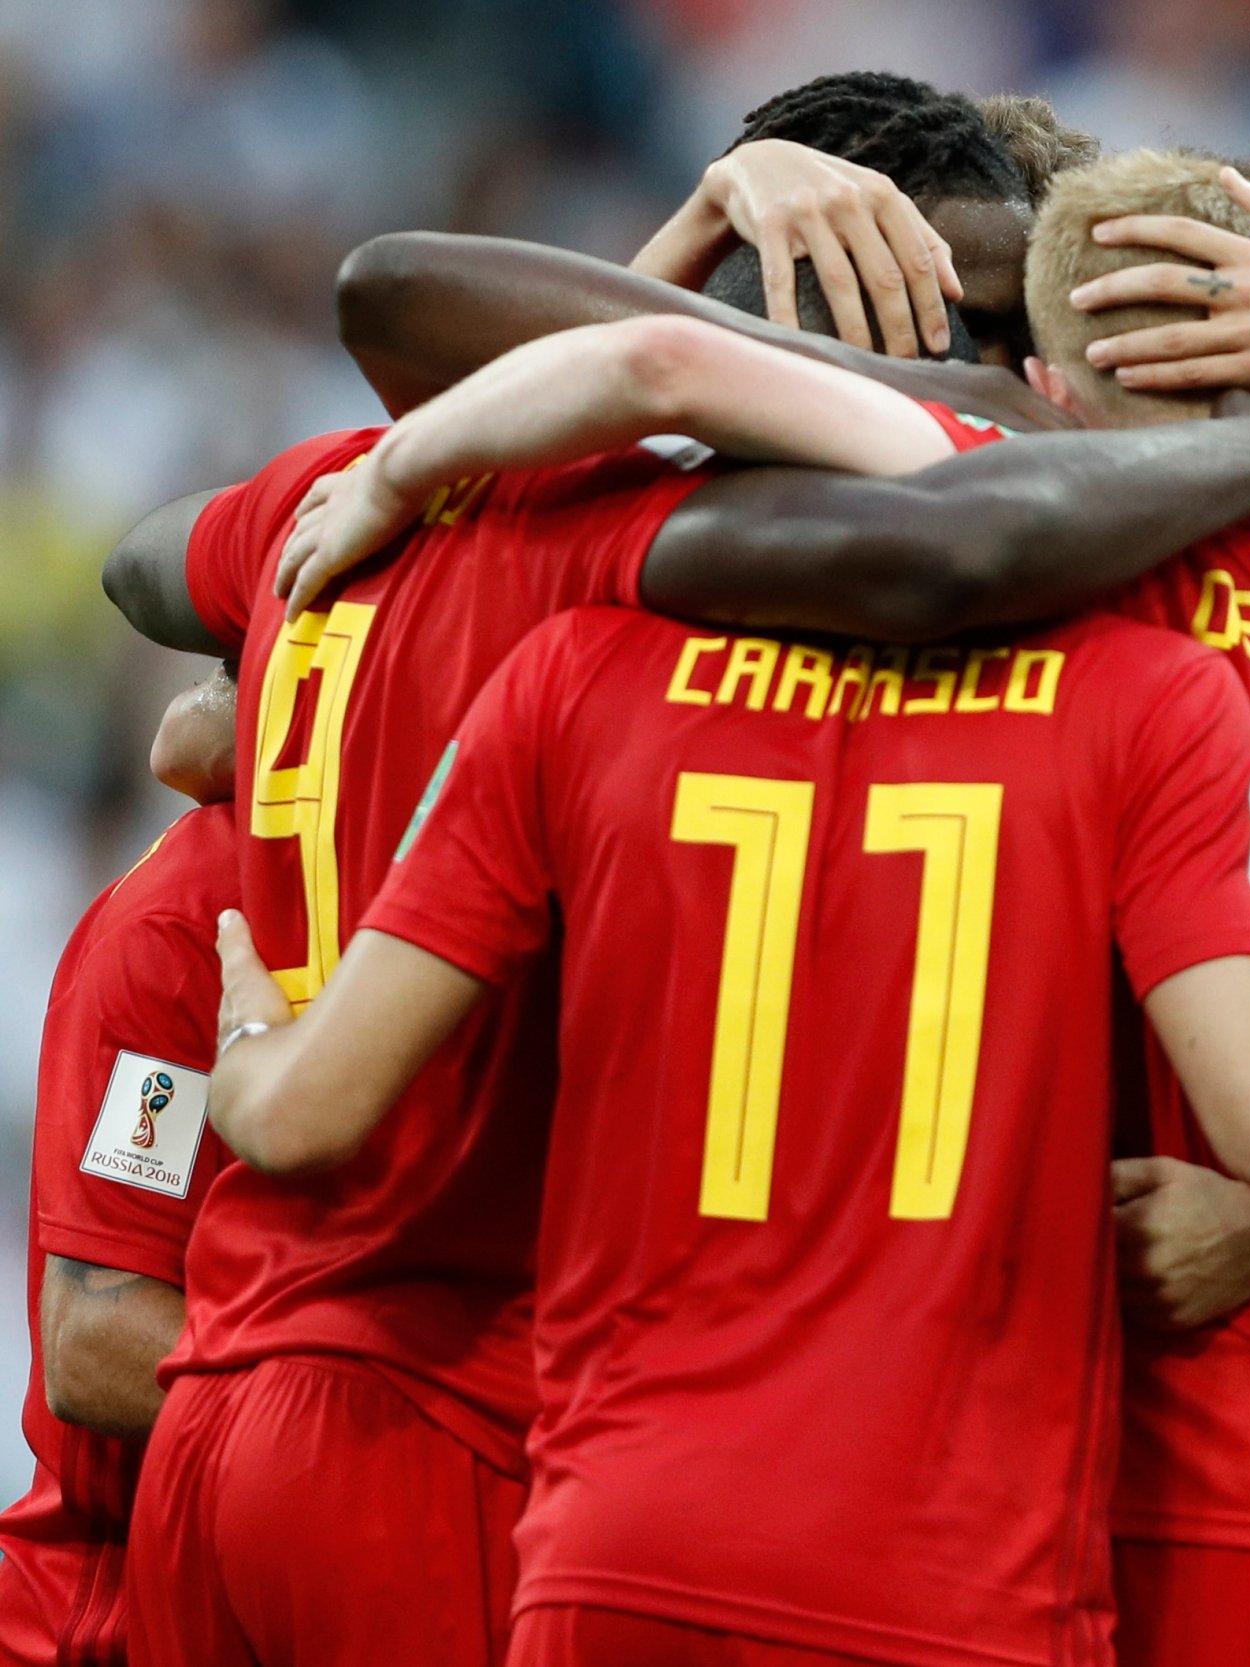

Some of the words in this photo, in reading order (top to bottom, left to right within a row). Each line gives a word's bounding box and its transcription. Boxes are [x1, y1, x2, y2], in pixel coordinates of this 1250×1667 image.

[665, 636, 1066, 723] CARRASCO
[251, 601, 378, 1020] 9
[670, 771, 1004, 1222] 11
[91, 1151, 143, 1177] RUSSIA
[145, 1166, 181, 1187] 2018
[113, 1148, 126, 1157] FIFA
[126, 1152, 150, 1164] WORLD
[150, 1158, 164, 1167] CUP
